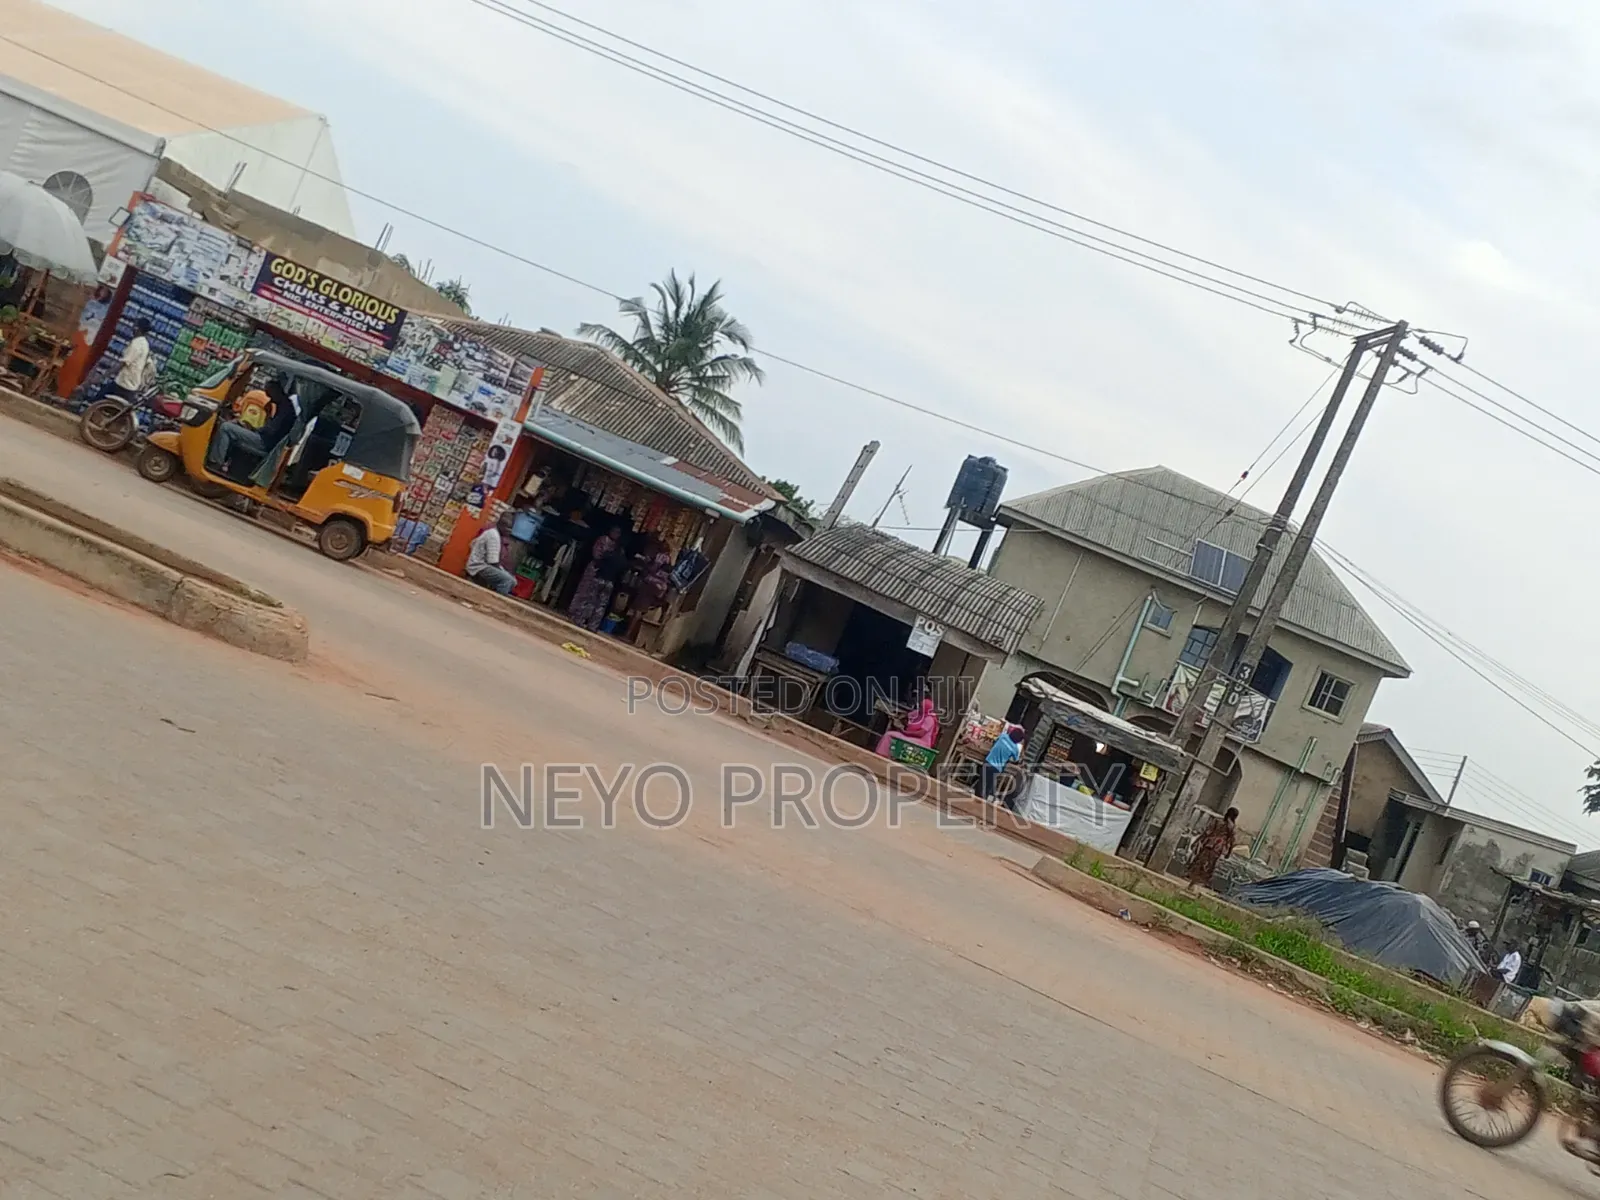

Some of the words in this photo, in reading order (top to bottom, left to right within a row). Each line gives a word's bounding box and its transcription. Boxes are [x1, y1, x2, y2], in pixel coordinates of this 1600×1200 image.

[270, 258, 319, 289] GOD'S
[319, 278, 400, 324] GLORIOUS
[273, 277, 327, 306] CHUKS
[329, 299, 341, 312] &
[343, 307, 387, 331] SONS
[304, 300, 369, 331] ENTERPRISES
[914, 615, 945, 637] POS
